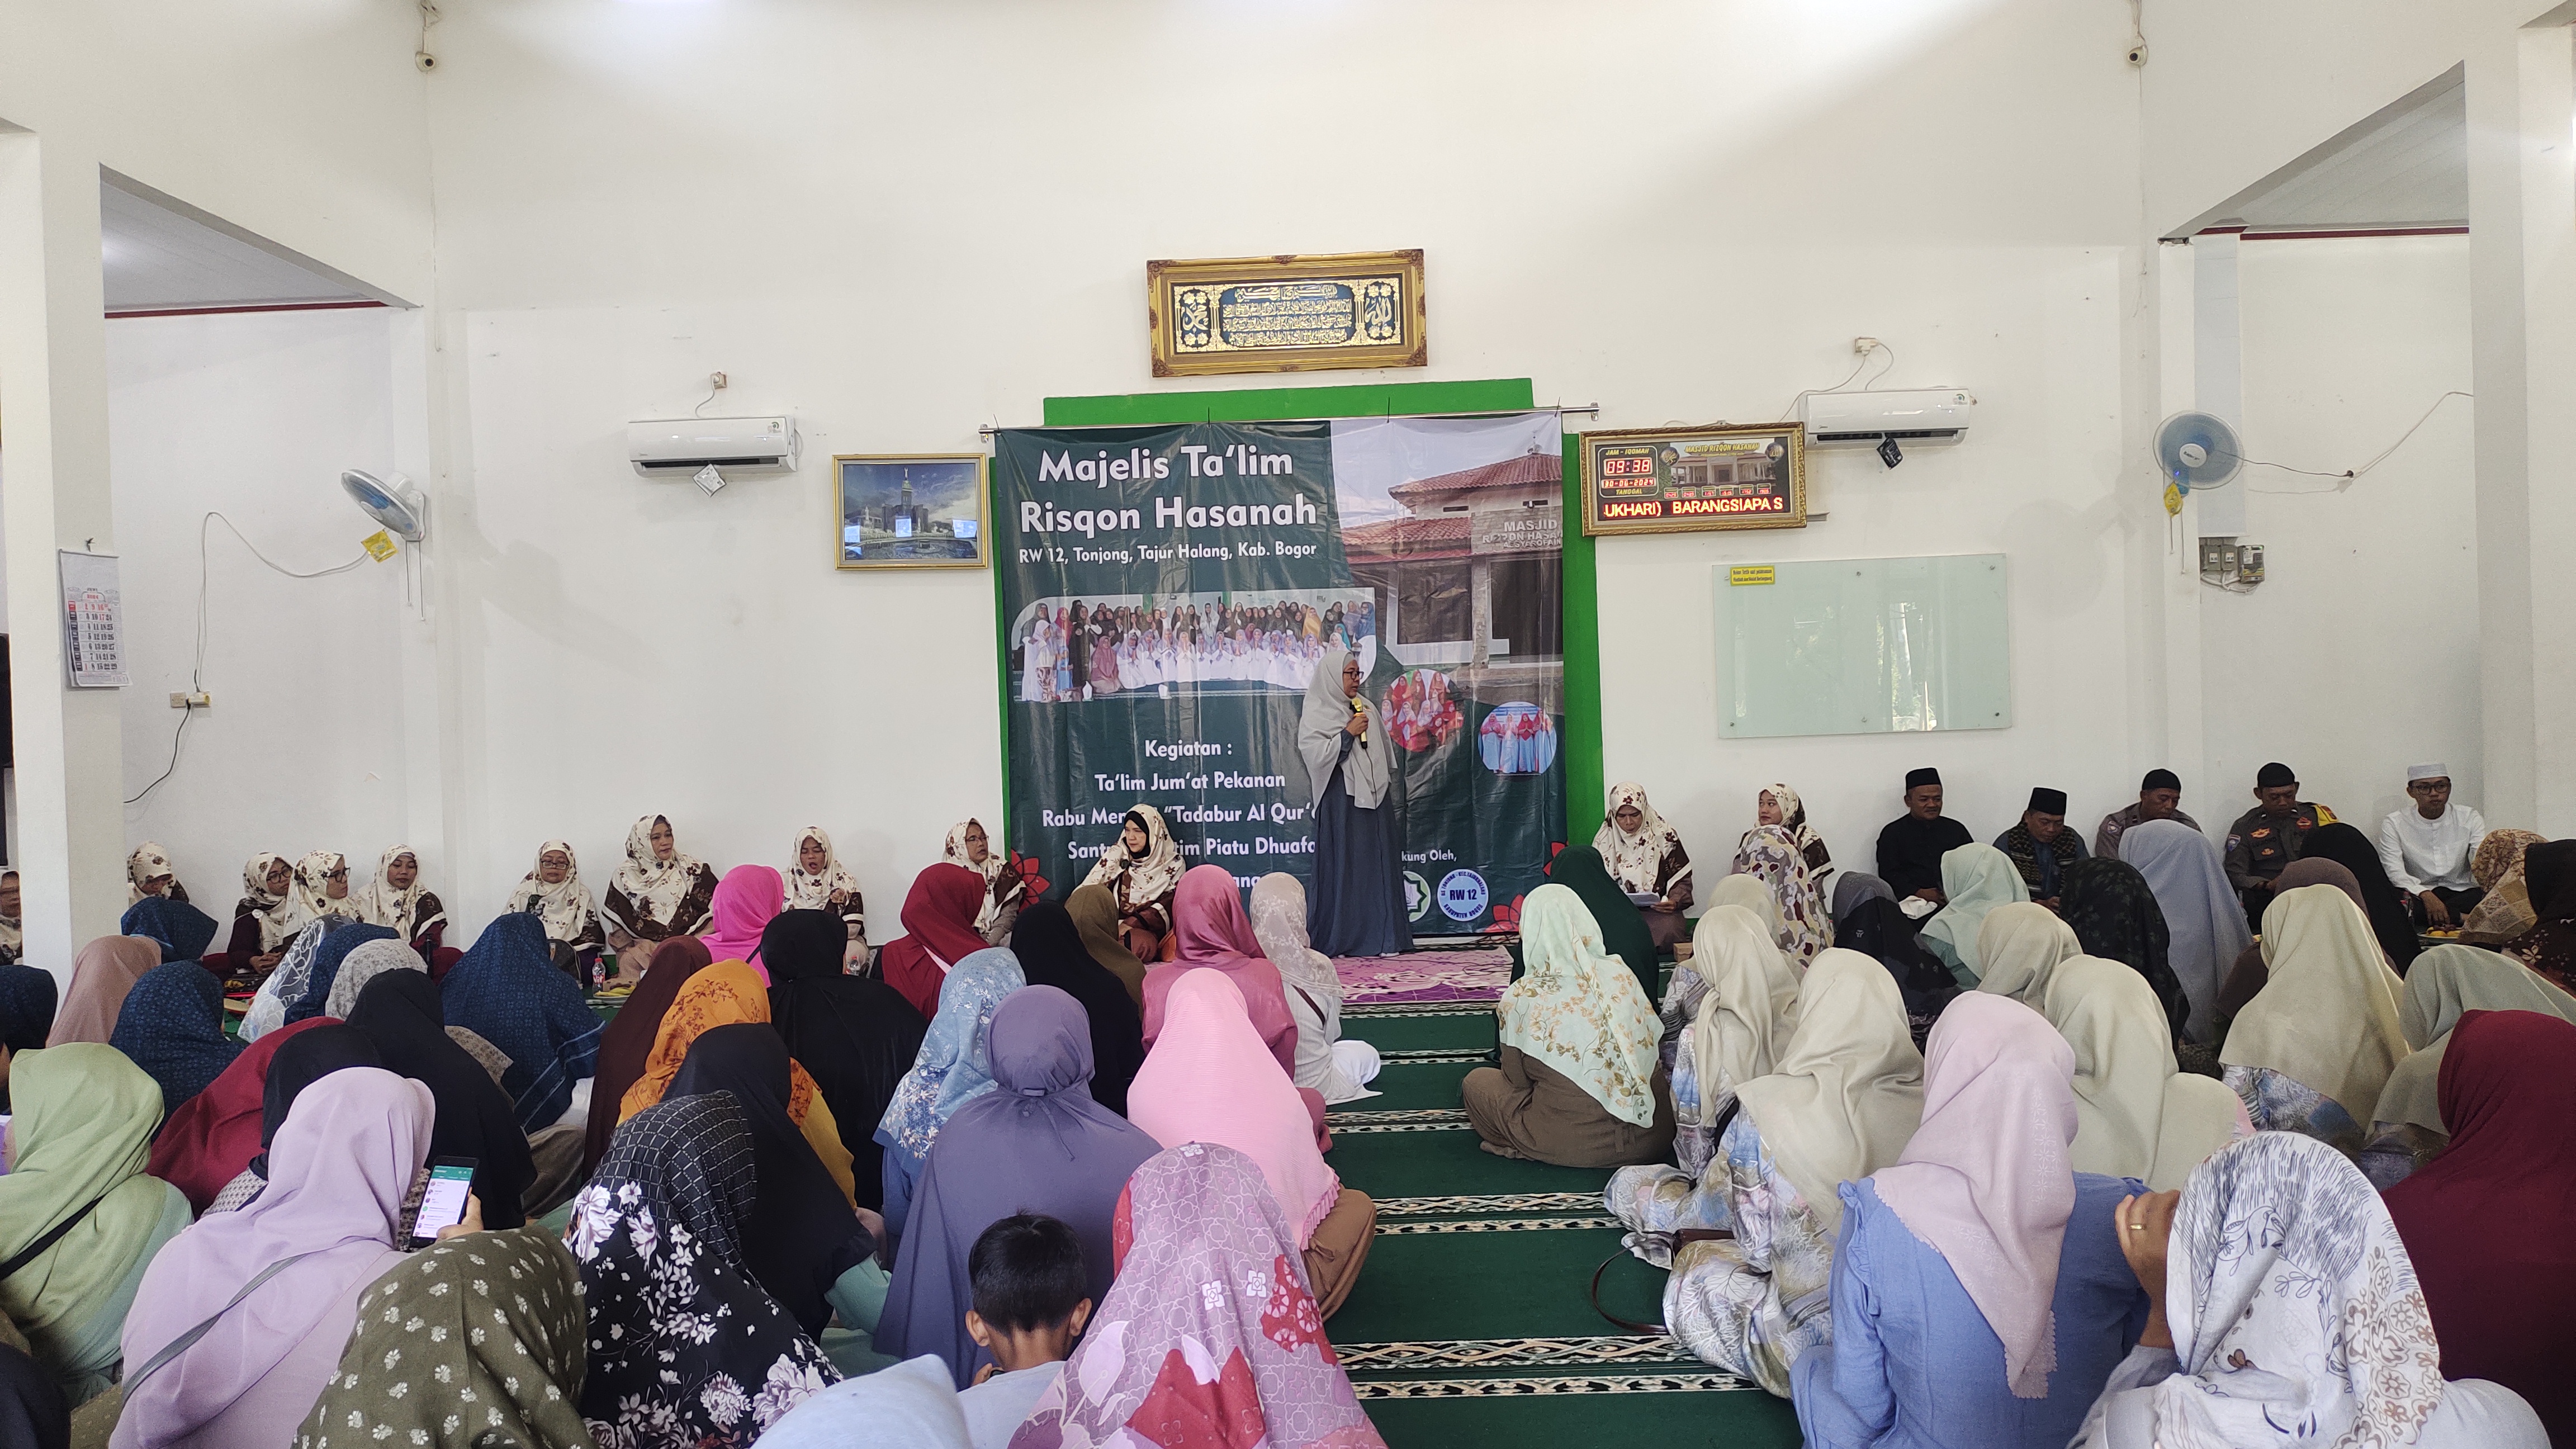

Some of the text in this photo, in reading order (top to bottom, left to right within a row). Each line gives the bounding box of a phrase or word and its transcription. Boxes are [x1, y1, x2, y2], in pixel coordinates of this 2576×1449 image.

[1038, 444, 1293, 489] Majelis Ta'lim
[1607, 459, 1650, 474] 09:38
[1020, 493, 1318, 539] Risqon Hasanah
[1672, 498, 1772, 514] BARANGSIAPA
[1504, 519, 1558, 532] MASJID
[1019, 540, 1317, 565] RW 12, Tonjong, Tajur Halang, Kab. Bogor
[1145, 738, 1221, 761] Kegiatan
[1094, 773, 1145, 791] Ta'lim
[1214, 770, 1286, 789] Pekanan
[1043, 809, 1086, 827] Rabu
[1247, 803, 1265, 821] Al
[1174, 839, 1200, 856] tim
[1206, 837, 1249, 855] Piatu
[1401, 849, 1457, 864] kung Oleh,
[1450, 889, 1478, 901] RW 12
